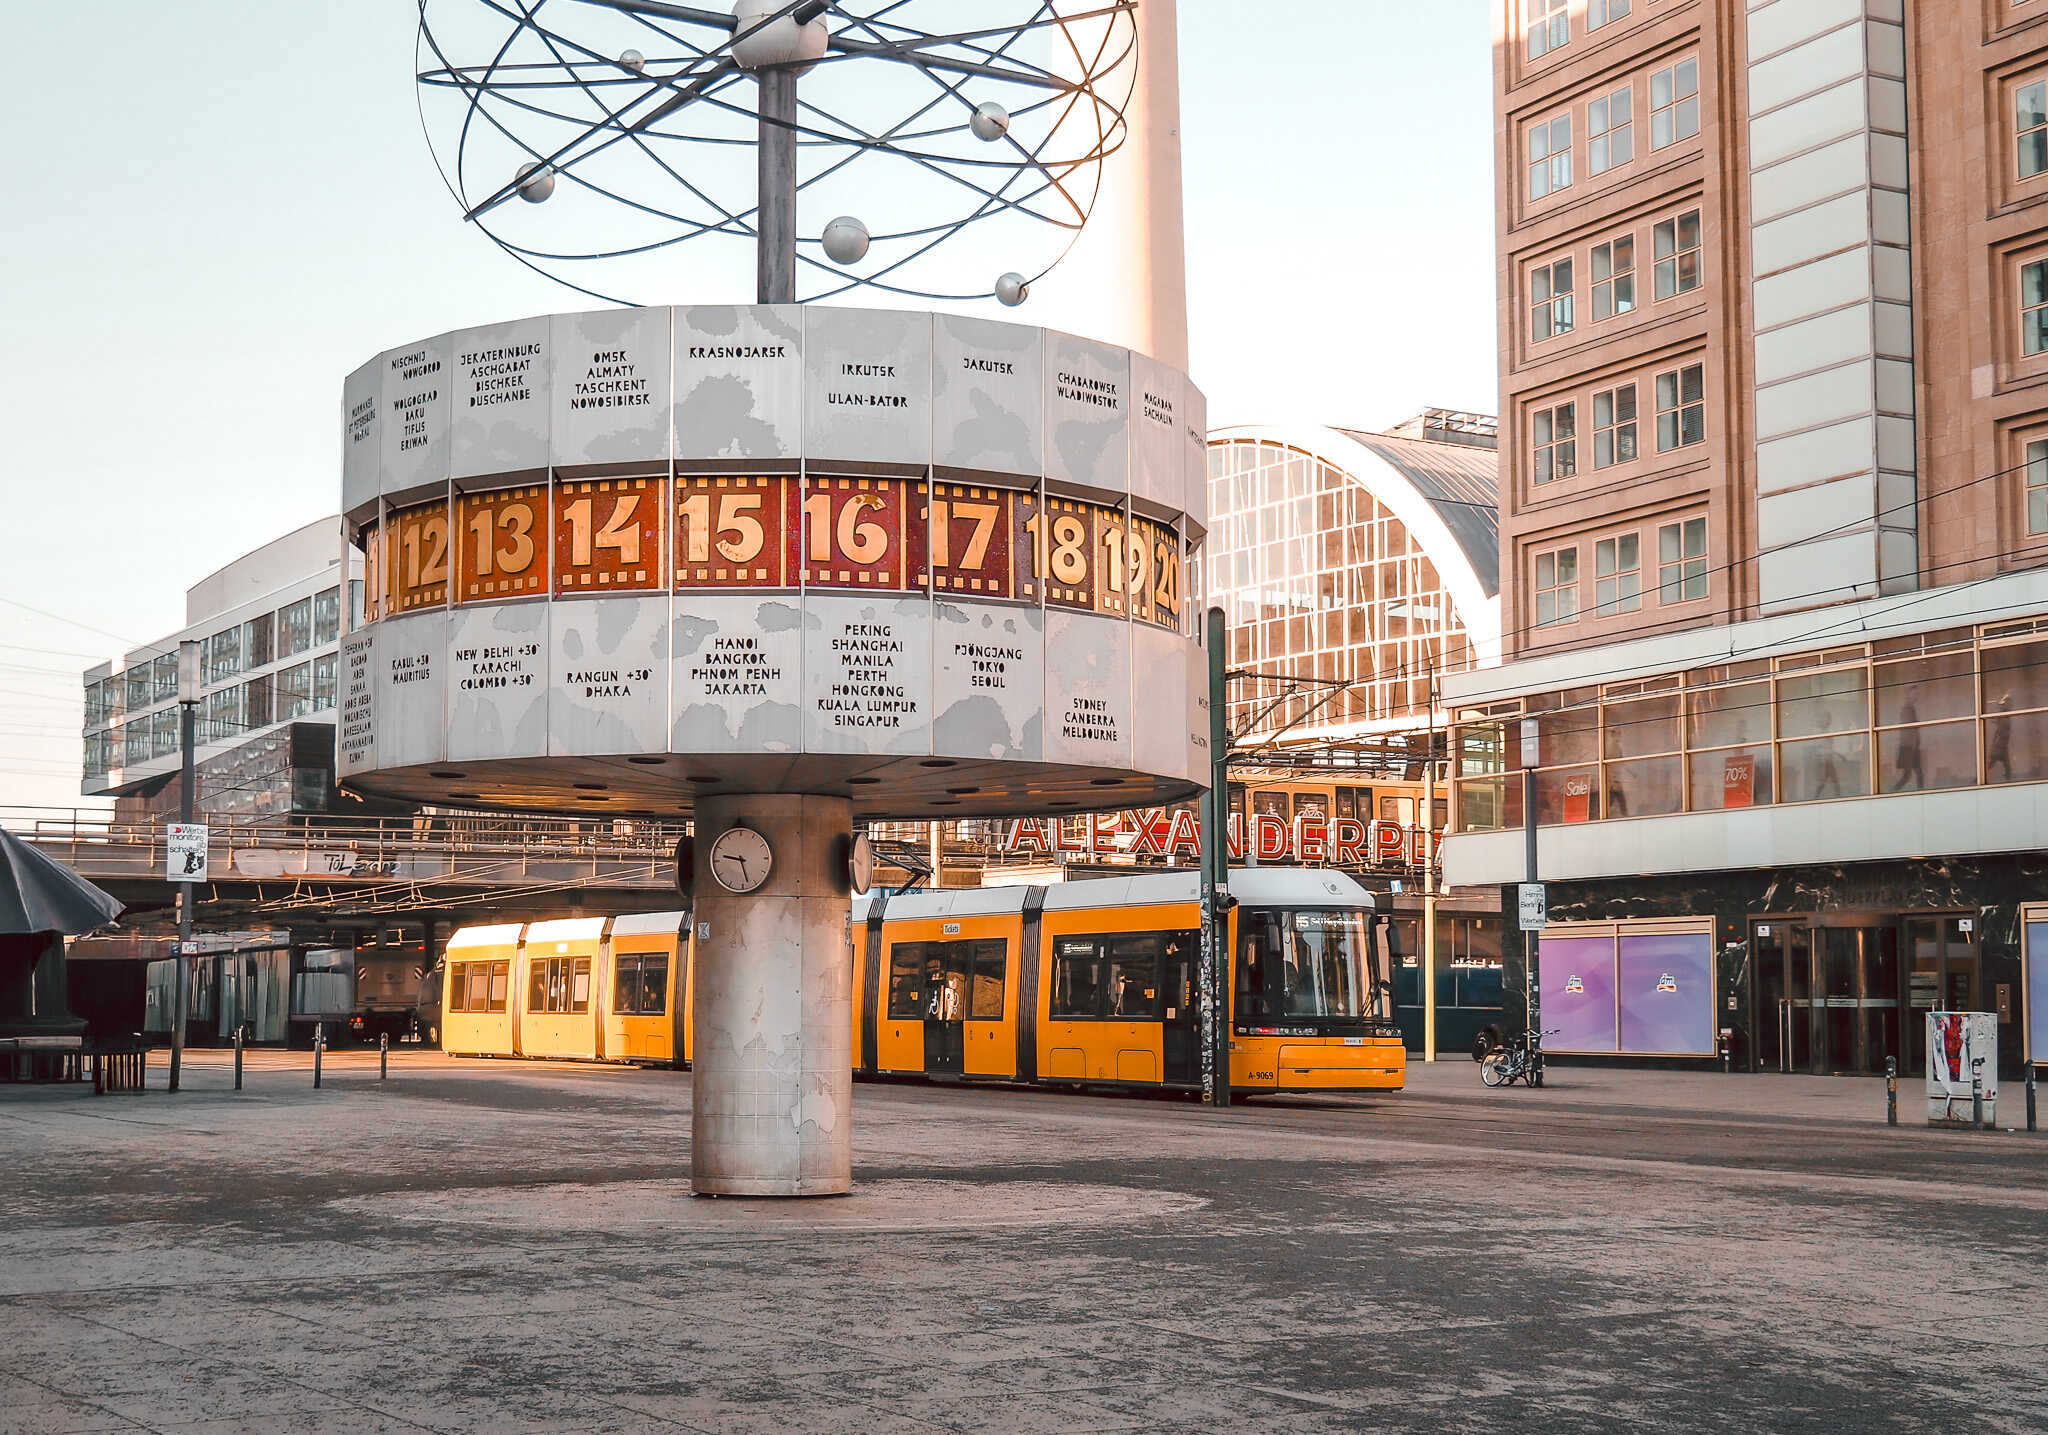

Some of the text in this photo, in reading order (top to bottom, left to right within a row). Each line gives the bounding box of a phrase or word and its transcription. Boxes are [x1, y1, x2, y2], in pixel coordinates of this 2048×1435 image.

[391, 351, 426, 370] NISCHNIJ
[460, 343, 541, 366] JEKATERINBURG
[593, 350, 628, 363] OMSK
[689, 346, 785, 359] KRASNOJARSK
[402, 361, 441, 380] NOWGOROD
[470, 359, 531, 379] ASCHGABAT
[586, 364, 635, 379] ALMATY
[840, 363, 896, 378] IRKUTSK
[962, 357, 1014, 375] JAKUTSK
[475, 375, 525, 392] BISCHKEK
[575, 379, 647, 395] TASCHKENT
[1057, 371, 1118, 396] CHABAROWSK
[393, 390, 438, 411] WOLGOGRAD
[470, 388, 531, 408] DUSCHANBE
[570, 392, 651, 410] NOWOSIBIRSK
[828, 392, 908, 409] ULAN-BATOR
[1056, 385, 1119, 411] WLADIWOSTOK
[1144, 391, 1173, 413] MAGADAN
[405, 408, 425, 422] BAKU
[404, 421, 425, 436] TIFLIS
[400, 435, 428, 451] ERIWAN
[562, 495, 643, 566] 14
[679, 493, 764, 564] 15
[804, 493, 888, 564] 16
[921, 501, 999, 570] 17
[469, 503, 535, 576] 13
[404, 516, 449, 588] 12
[1026, 513, 1087, 585] 18
[1103, 527, 1148, 595] 19
[1155, 542, 1180, 615] 20
[845, 624, 891, 637] PEKING
[714, 638, 759, 650] HANOI
[832, 639, 903, 653] SHANGHAI
[954, 643, 1023, 661] PJÖNGJANG
[456, 649, 478, 662] NEW
[483, 646, 514, 659] DELHI
[705, 652, 767, 665] BANGKOK
[841, 654, 894, 667] MANILA
[392, 658, 415, 670] KABUL
[472, 661, 522, 674] KARACHI
[972, 661, 1006, 673] TOKYO
[392, 669, 430, 684] MAURITIUS
[566, 671, 619, 684] RANGUN
[691, 667, 781, 680] PHNOM PENH
[848, 670, 888, 682] PERTH
[460, 676, 508, 690] COLOMBO
[704, 684, 767, 696] JAKARTA
[971, 675, 1006, 689] SEOUL
[585, 685, 631, 698] DHAKA
[831, 684, 904, 697] HONGKONG
[818, 699, 917, 714] KUALA LUMPUR
[1073, 697, 1107, 711] SYDNEY
[834, 715, 899, 728] SINGAPUR
[1064, 711, 1116, 727] CANBERRA
[1062, 726, 1118, 742] MELBOURNE
[1725, 767, 1748, 781] 70%
[1565, 781, 1588, 797] Sale
[1005, 808, 1446, 868] ALEXANDERPL
[1247, 1071, 1274, 1080] A-9069
